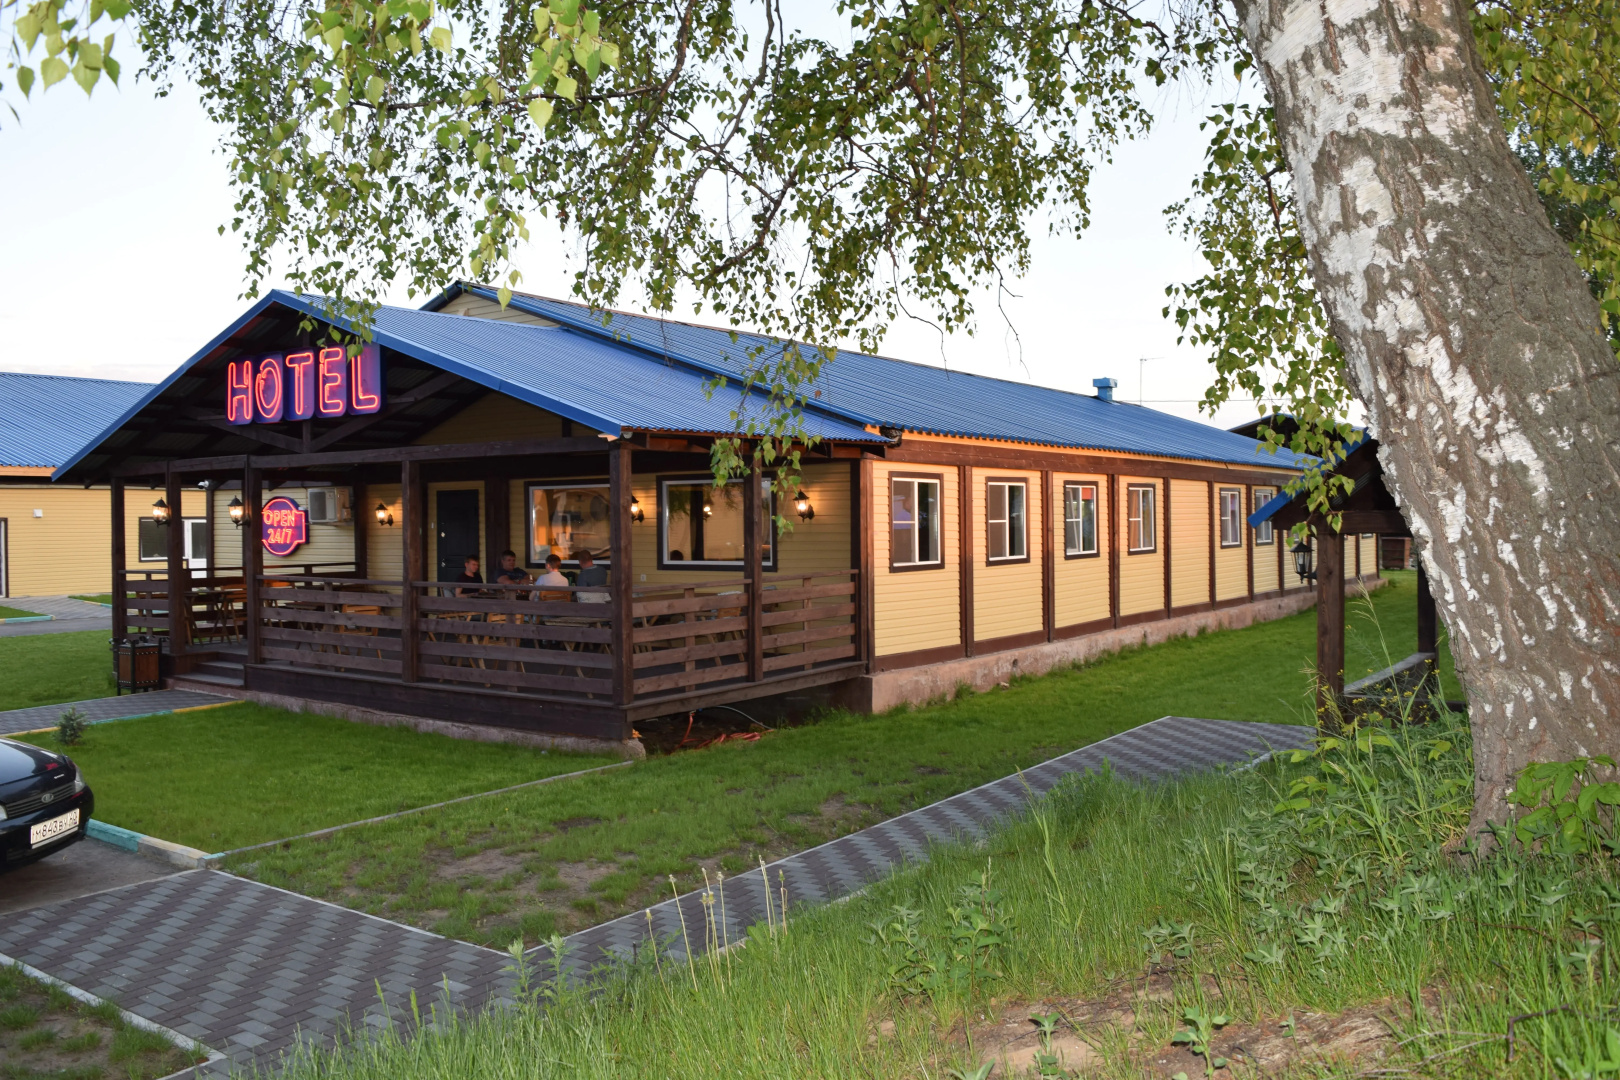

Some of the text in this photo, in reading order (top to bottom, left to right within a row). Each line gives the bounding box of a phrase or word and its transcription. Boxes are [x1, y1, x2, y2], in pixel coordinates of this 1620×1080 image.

[227, 347, 378, 421] HOTEL
[263, 509, 295, 527] OPEN
[267, 528, 293, 544] 24/7
